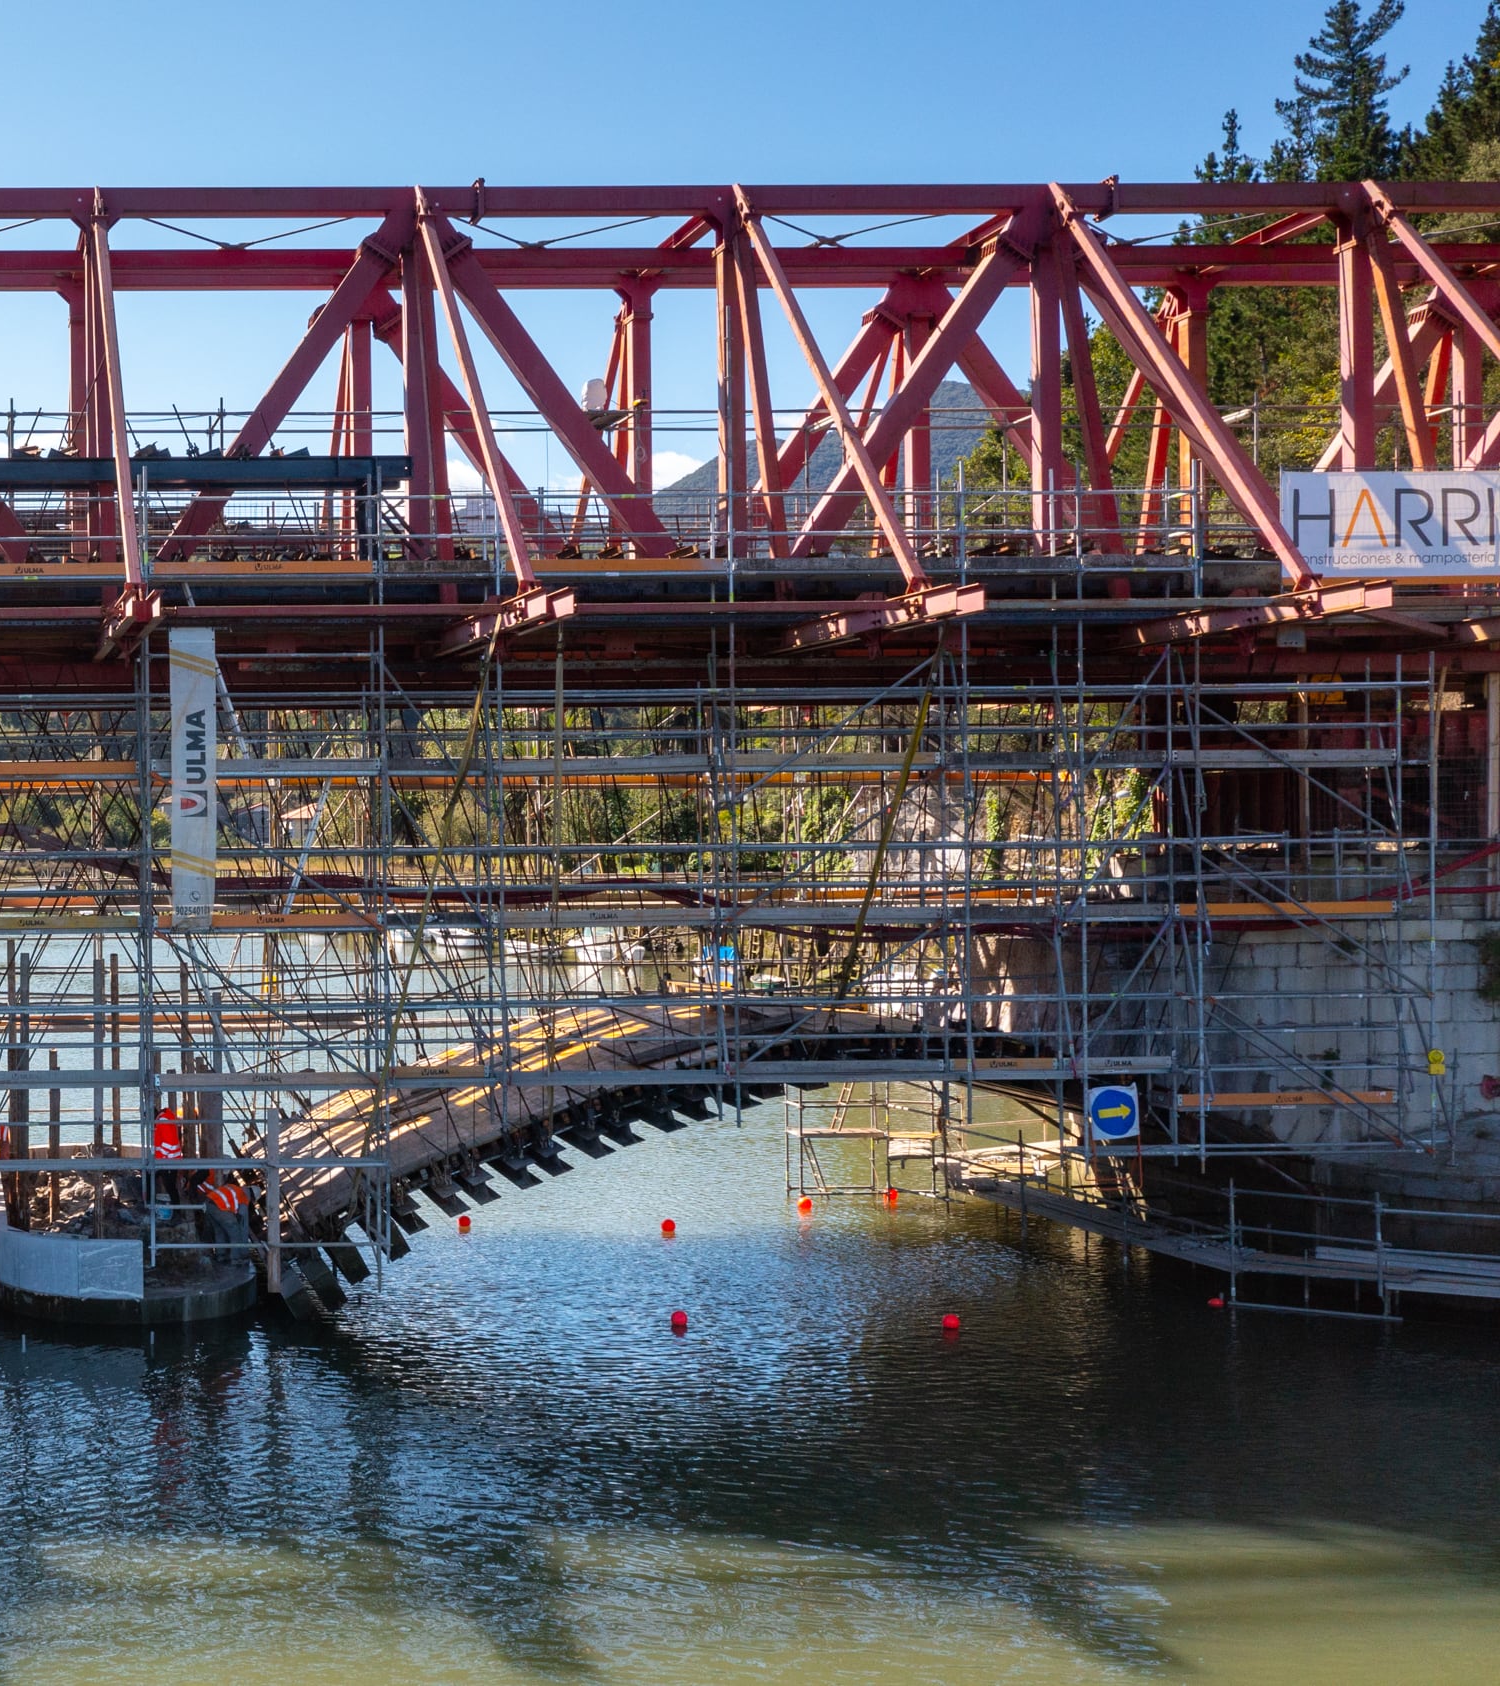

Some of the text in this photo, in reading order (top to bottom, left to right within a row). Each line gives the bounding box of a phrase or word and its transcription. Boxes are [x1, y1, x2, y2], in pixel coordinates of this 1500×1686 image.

[1293, 488, 1495, 548] HARRI
[1302, 552, 1392, 564] onstrucciones
[1395, 552, 1405, 564] &
[186, 708, 206, 785] ULMA
